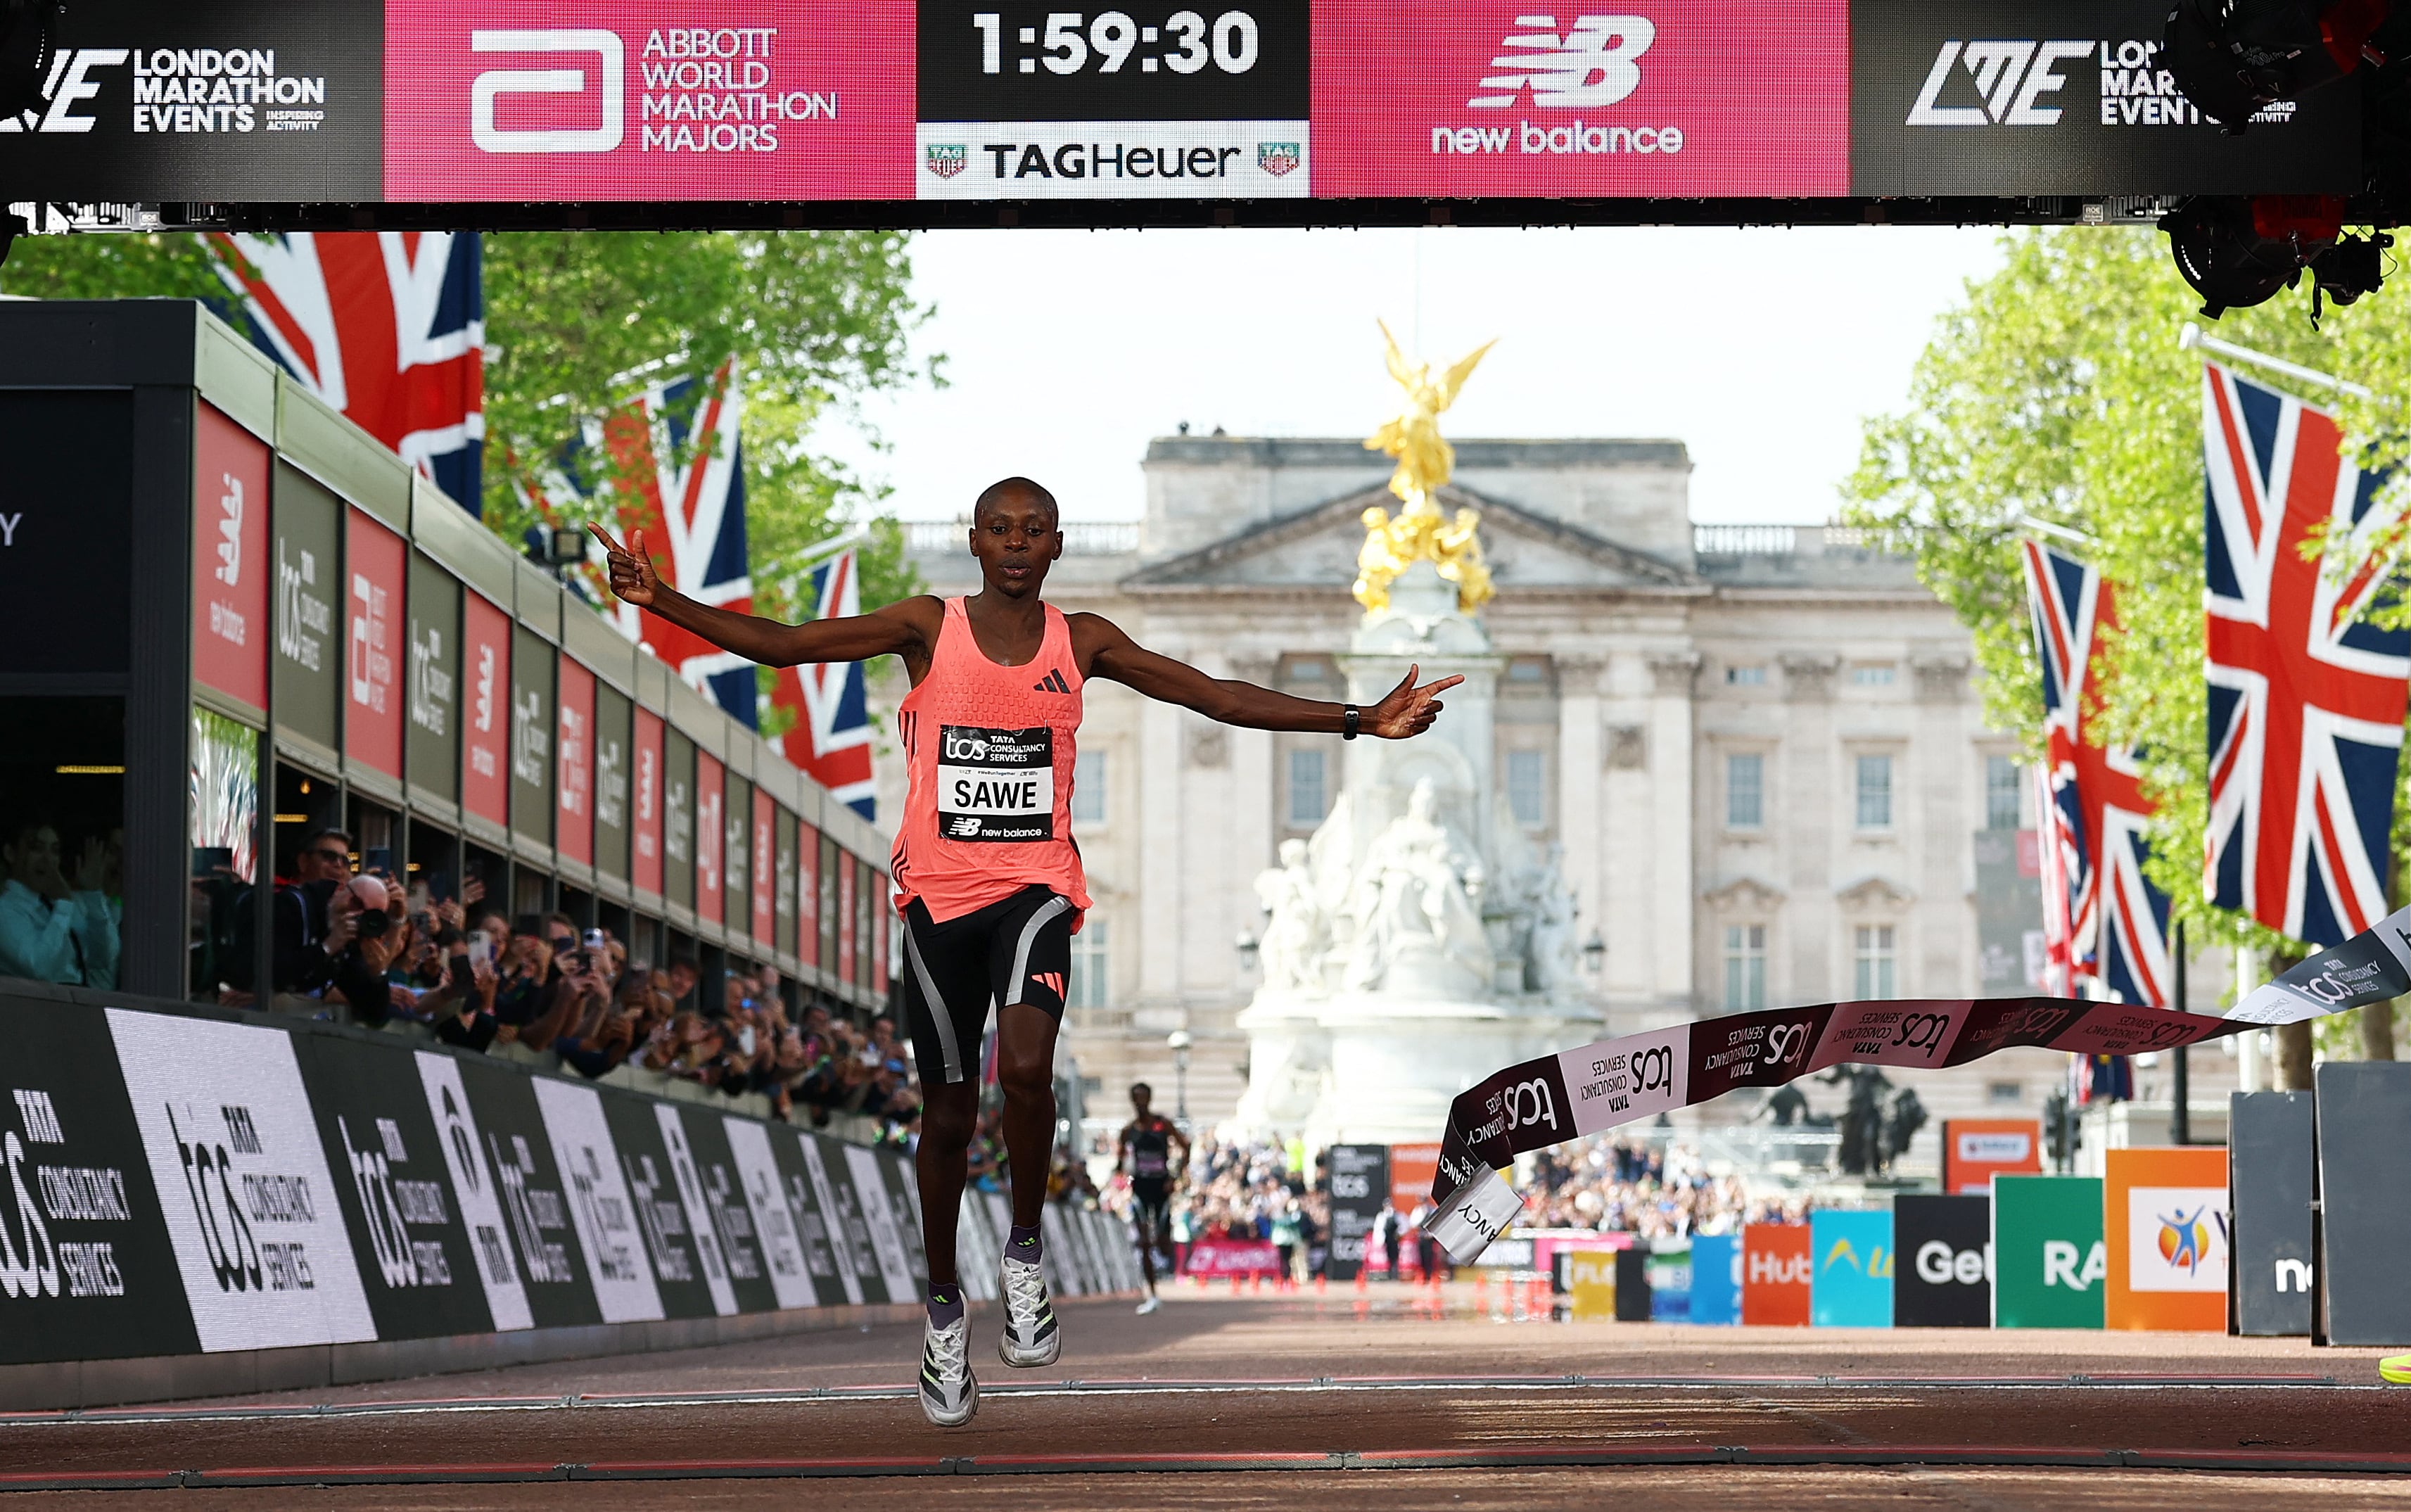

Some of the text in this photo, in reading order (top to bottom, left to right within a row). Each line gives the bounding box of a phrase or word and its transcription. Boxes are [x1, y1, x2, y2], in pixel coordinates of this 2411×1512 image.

[642, 27, 777, 58] ABBOTT
[973, 10, 1259, 75] 1:59:30
[133, 48, 274, 77] LONDON
[642, 61, 770, 90] WORLD
[133, 77, 324, 104] MARATHON
[133, 105, 256, 133] EVENTS
[642, 91, 837, 120] MARATHON
[2101, 96, 2222, 125] EVENT
[642, 123, 779, 153] MAJORS
[1431, 119, 1685, 155] new balance
[946, 732, 986, 761] tcs
[990, 735, 1015, 744] TATA
[990, 743, 1045, 754] CONSULTANCY
[989, 753, 1028, 762] SERVICES
[954, 779, 1037, 809] SAWE
[981, 827, 1042, 837] new balance
[2289, 971, 2354, 1005] tcs
[1858, 1012, 1903, 1024] SERVICES
[1728, 1026, 1766, 1046] SERVICES
[1764, 1020, 1812, 1069] tcs
[1831, 1027, 1892, 1044] CONSULTANCY
[1852, 1041, 1882, 1055] TATA
[1891, 1012, 1950, 1059] tcs
[1592, 1054, 1627, 1077] SERVICES
[1630, 1045, 1673, 1098] tcs
[1705, 1043, 1760, 1071] CONSULTANCY
[1730, 1061, 1755, 1079] TATA
[1580, 1074, 1628, 1102] CONSULTANCY
[1504, 1078, 1557, 1131] tcs
[1608, 1093, 1630, 1114] TATA
[165, 1102, 263, 1292] tcs
